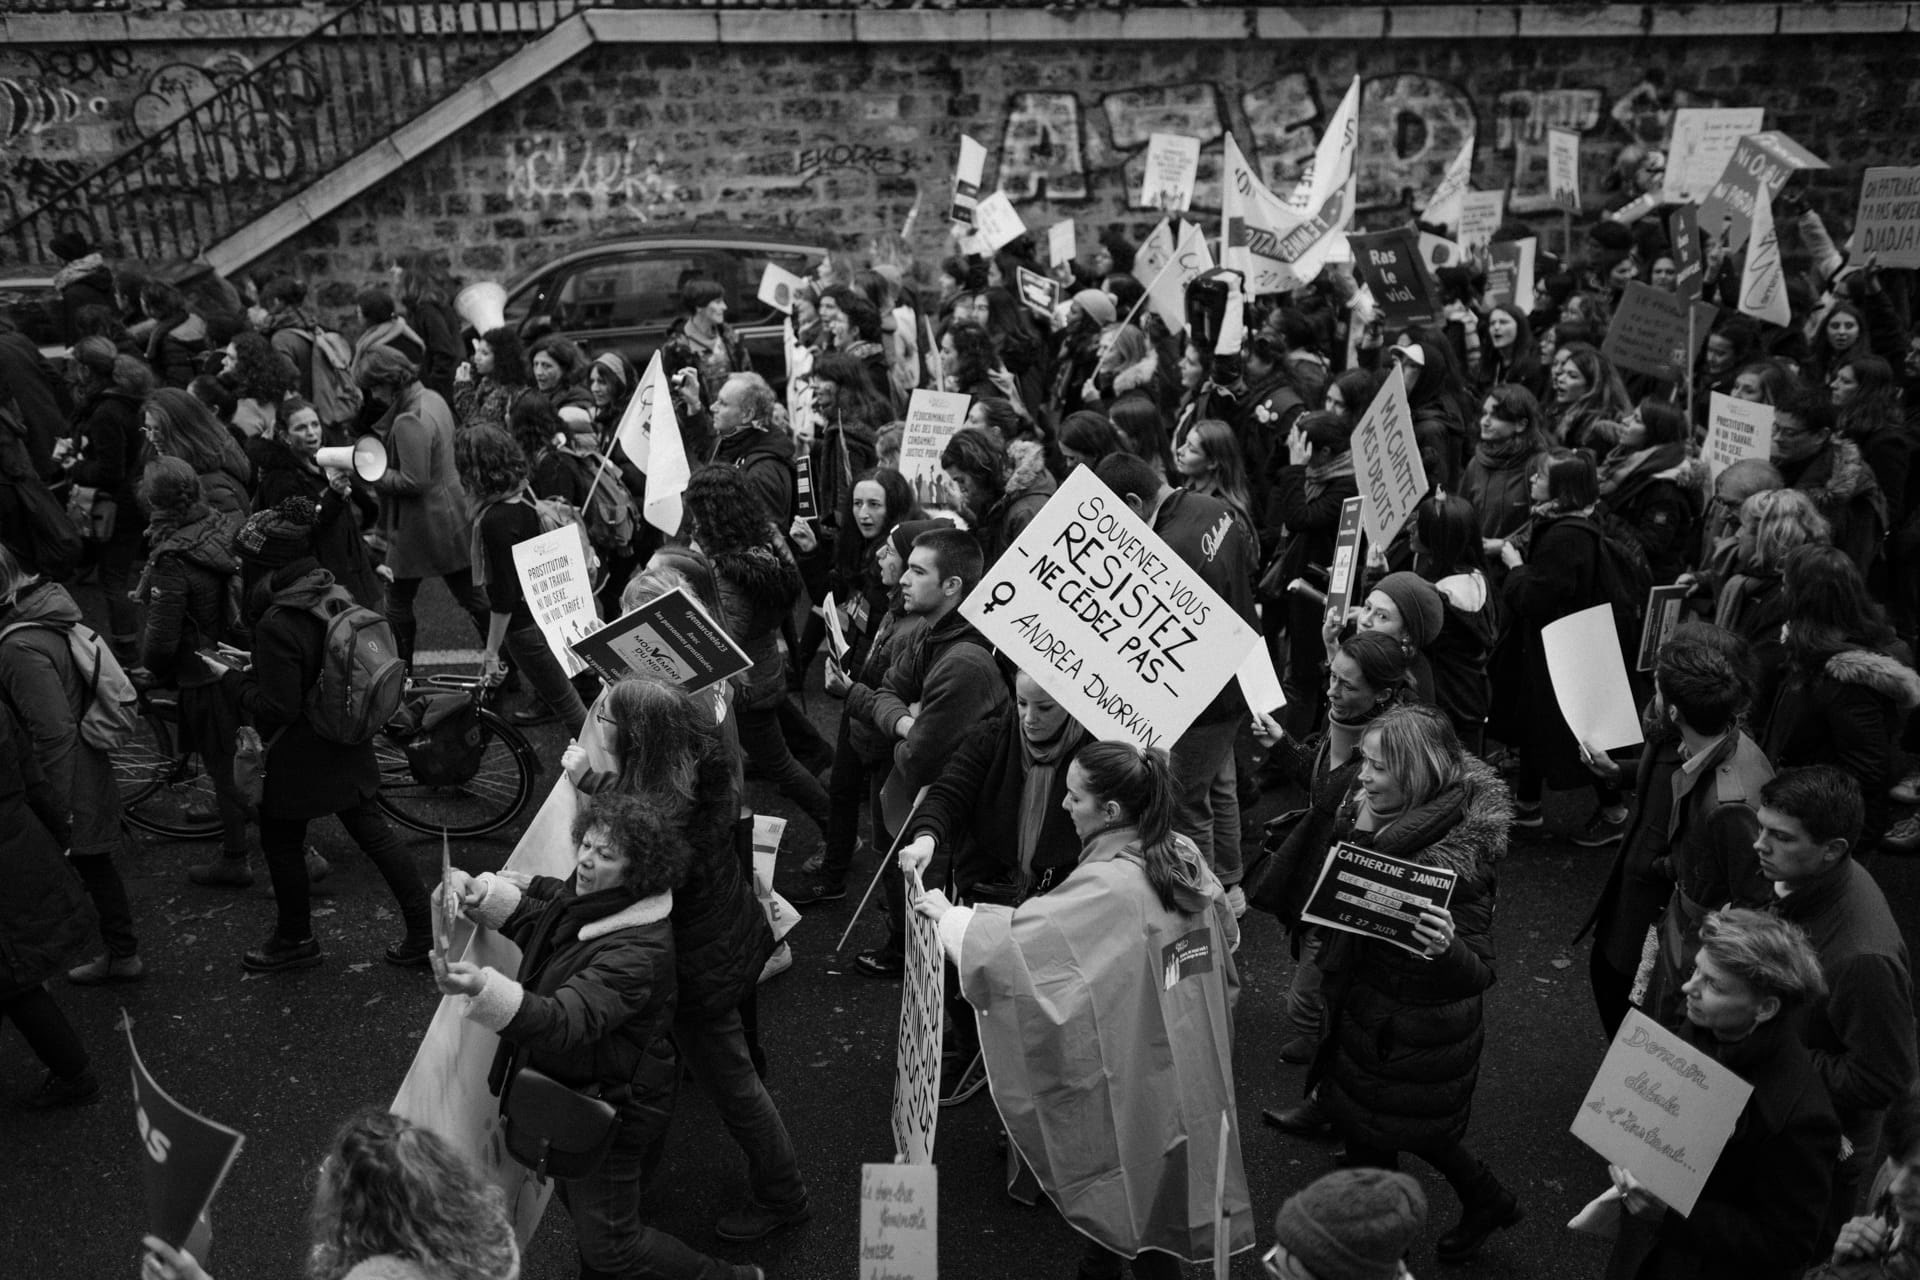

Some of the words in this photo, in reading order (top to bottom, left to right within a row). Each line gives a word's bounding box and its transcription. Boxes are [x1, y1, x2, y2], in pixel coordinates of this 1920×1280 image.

[1369, 249, 1397, 265] Ras
[1381, 268, 1397, 285] le
[1361, 415, 1379, 463] MES
[1367, 457, 1395, 532] DROITS
[528, 554, 569, 581] PROSTITUTION
[539, 580, 549, 593] UN
[1053, 521, 1199, 673] RESISTEZ
[544, 595, 552, 607] DU
[562, 595, 581, 615] TARIFÉ
[633, 634, 682, 681] MOUVEMENT
[1010, 613, 1084, 680] ANDREA
[634, 647, 647, 660] DU
[647, 659, 662, 673] NID
[1337, 849, 1406, 879] CATHERINE
[1409, 871, 1452, 891] JANNIN
[1339, 912, 1353, 923] LE
[1355, 917, 1369, 928] 27
[1372, 922, 1398, 937] JUIN
